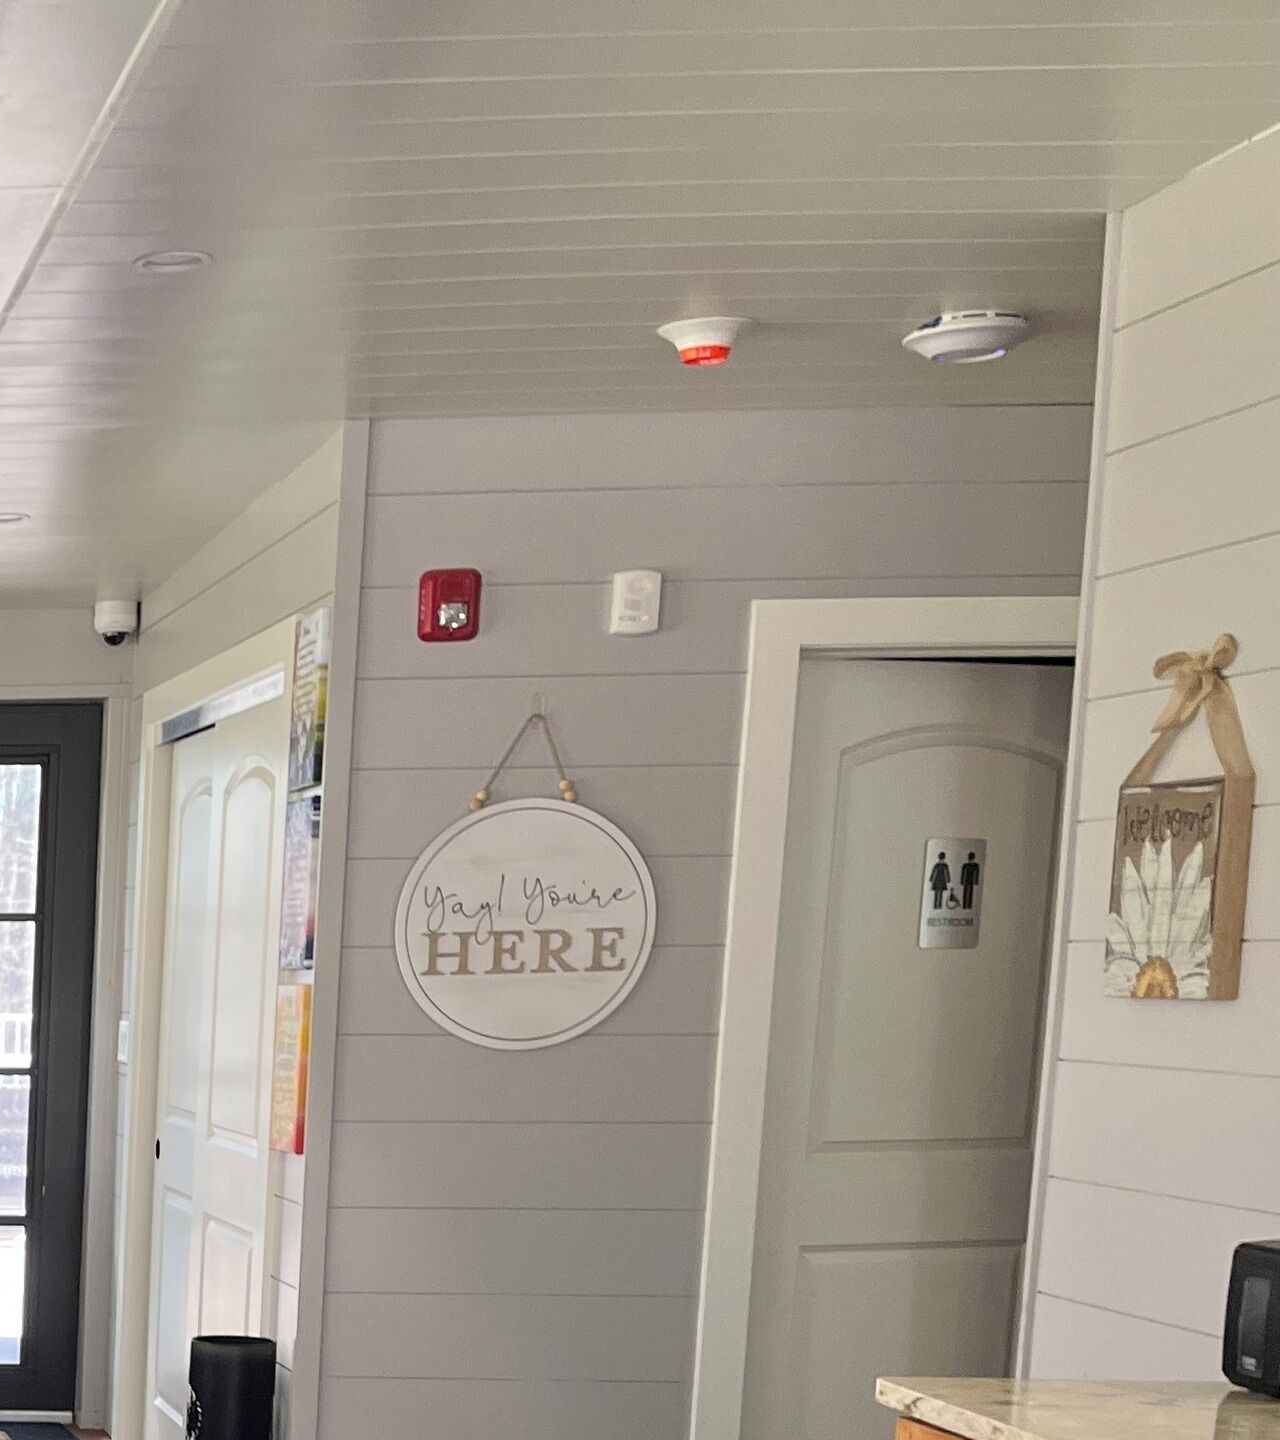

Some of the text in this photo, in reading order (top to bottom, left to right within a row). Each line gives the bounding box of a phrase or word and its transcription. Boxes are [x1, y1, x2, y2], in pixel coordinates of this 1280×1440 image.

[1123, 803, 1214, 845] Welcome
[424, 873, 636, 945] Yay! You're
[420, 927, 627, 976] HERE
